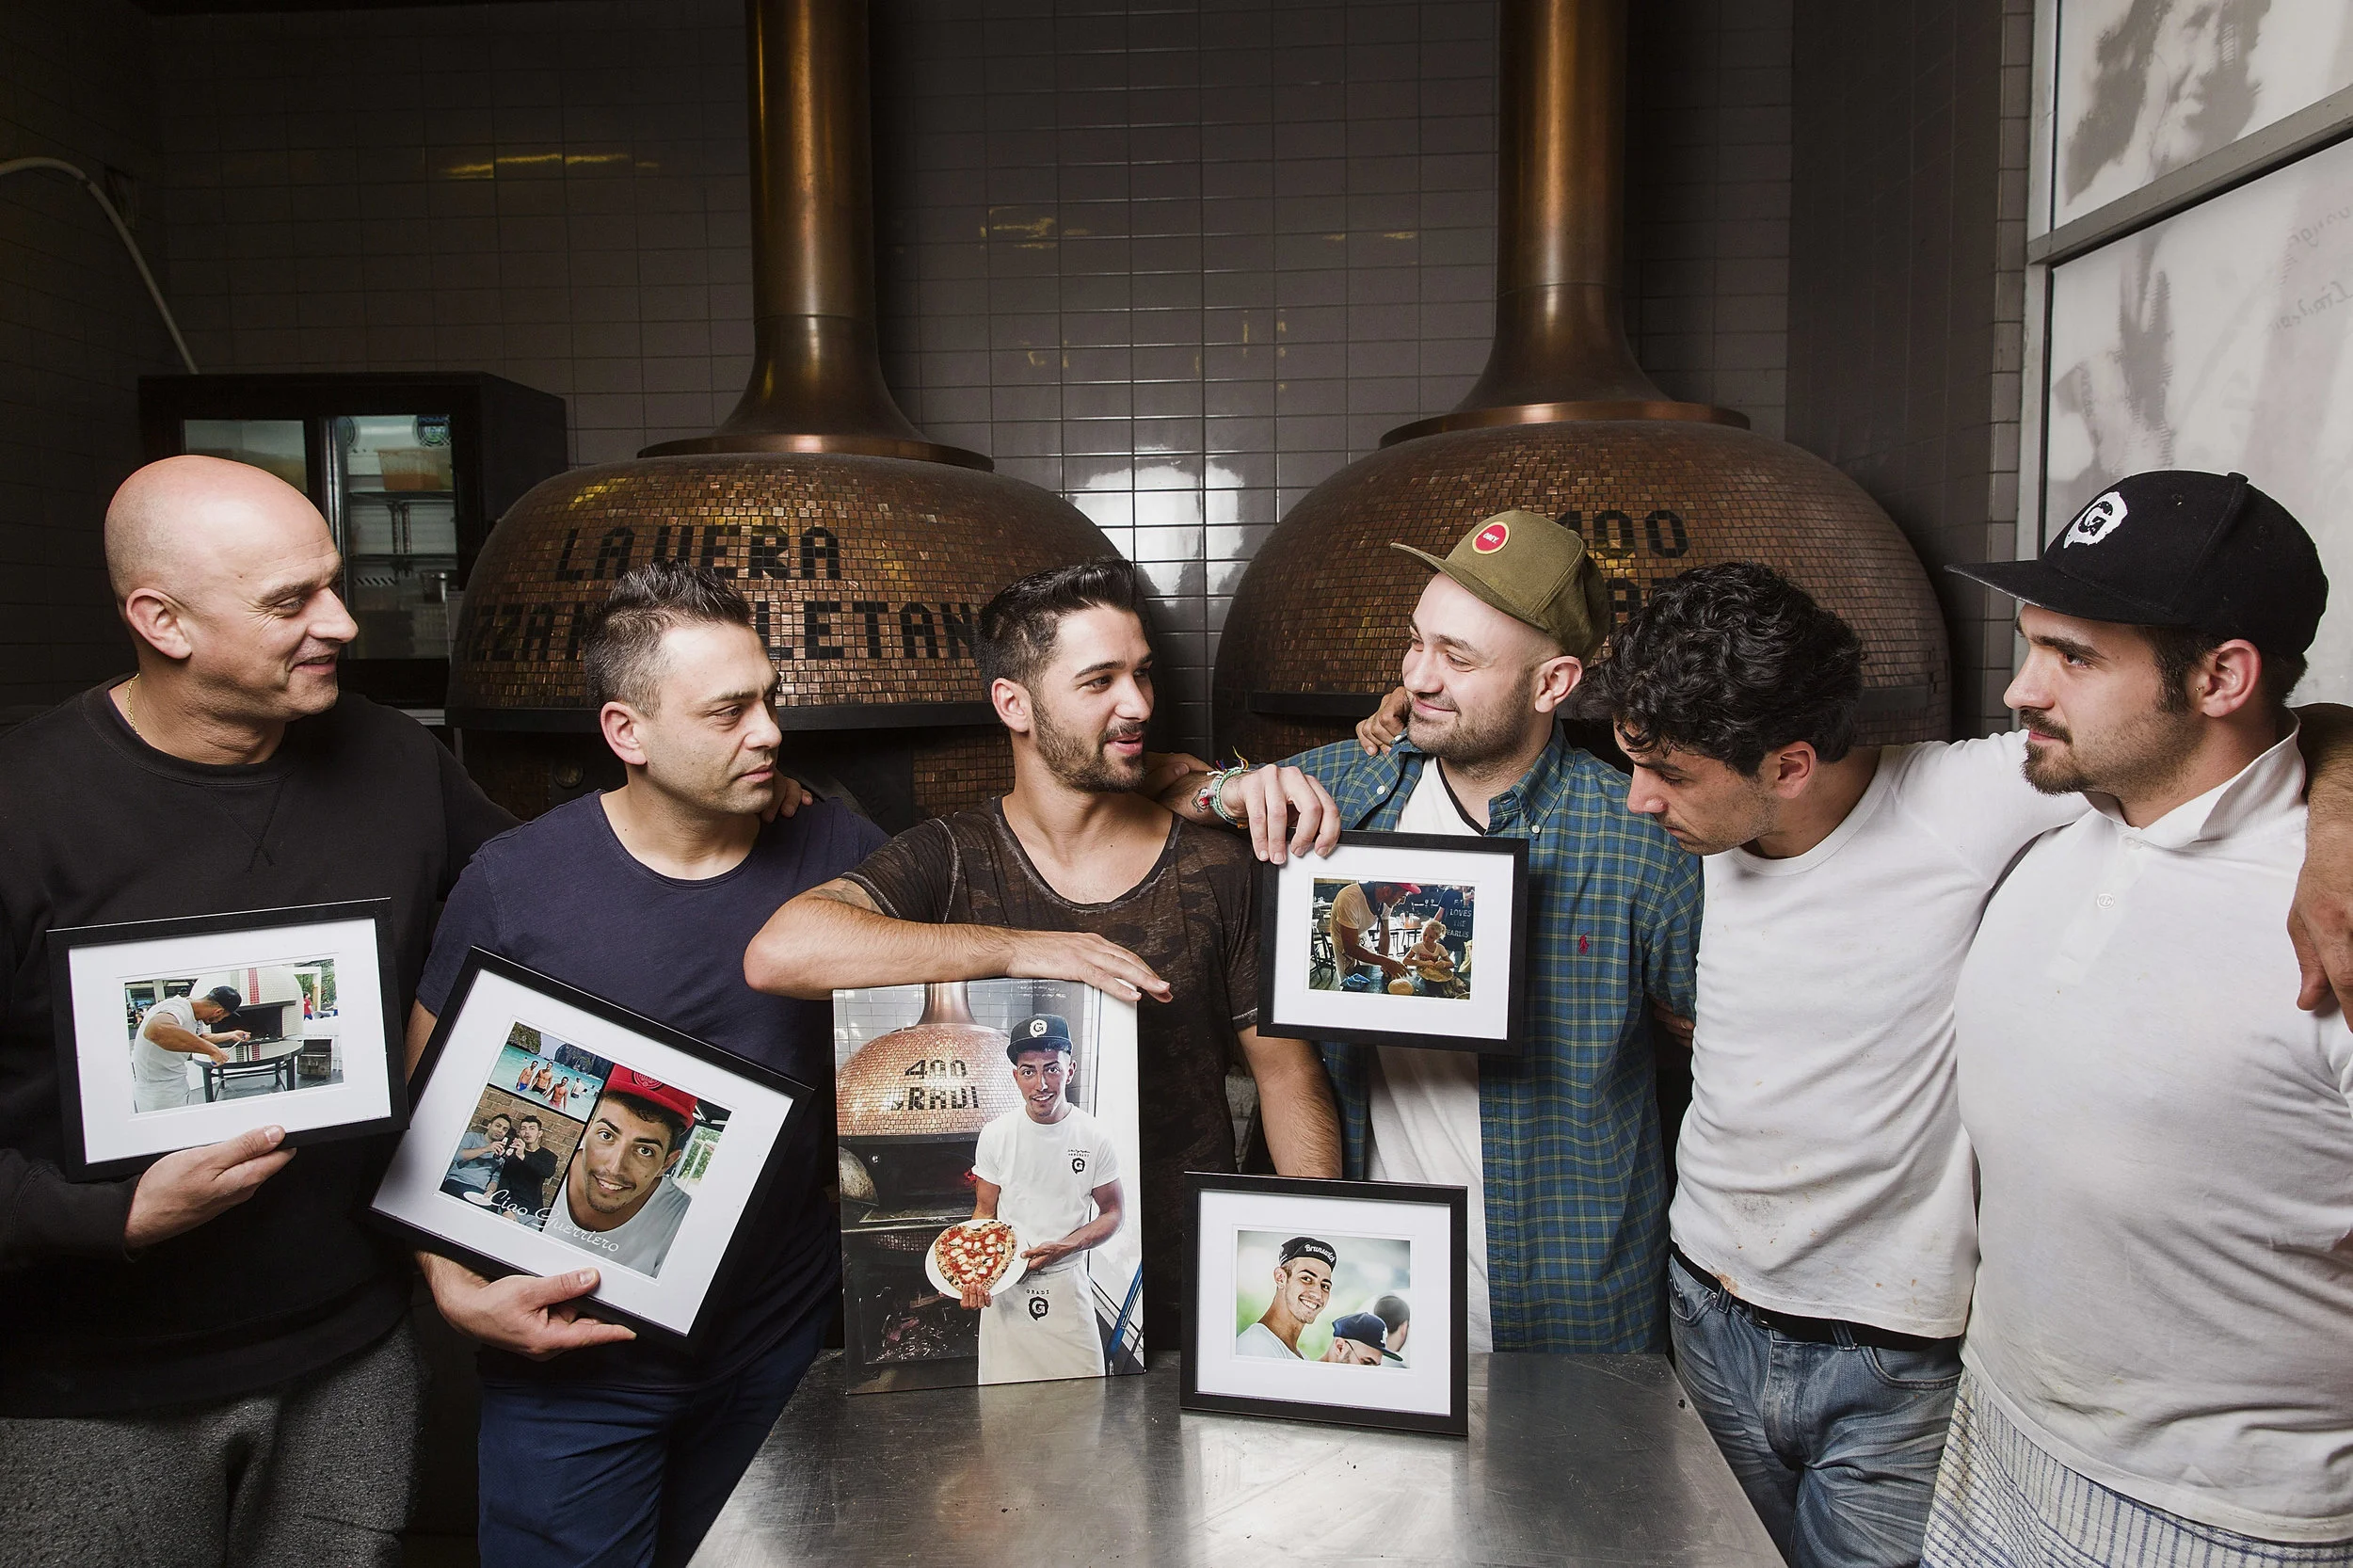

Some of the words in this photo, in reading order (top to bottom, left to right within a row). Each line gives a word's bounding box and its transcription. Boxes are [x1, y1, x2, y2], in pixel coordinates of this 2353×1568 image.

[557, 527, 634, 581] LA
[892, 1085, 979, 1111] RADI
[489, 1189, 528, 1216] Ciao
